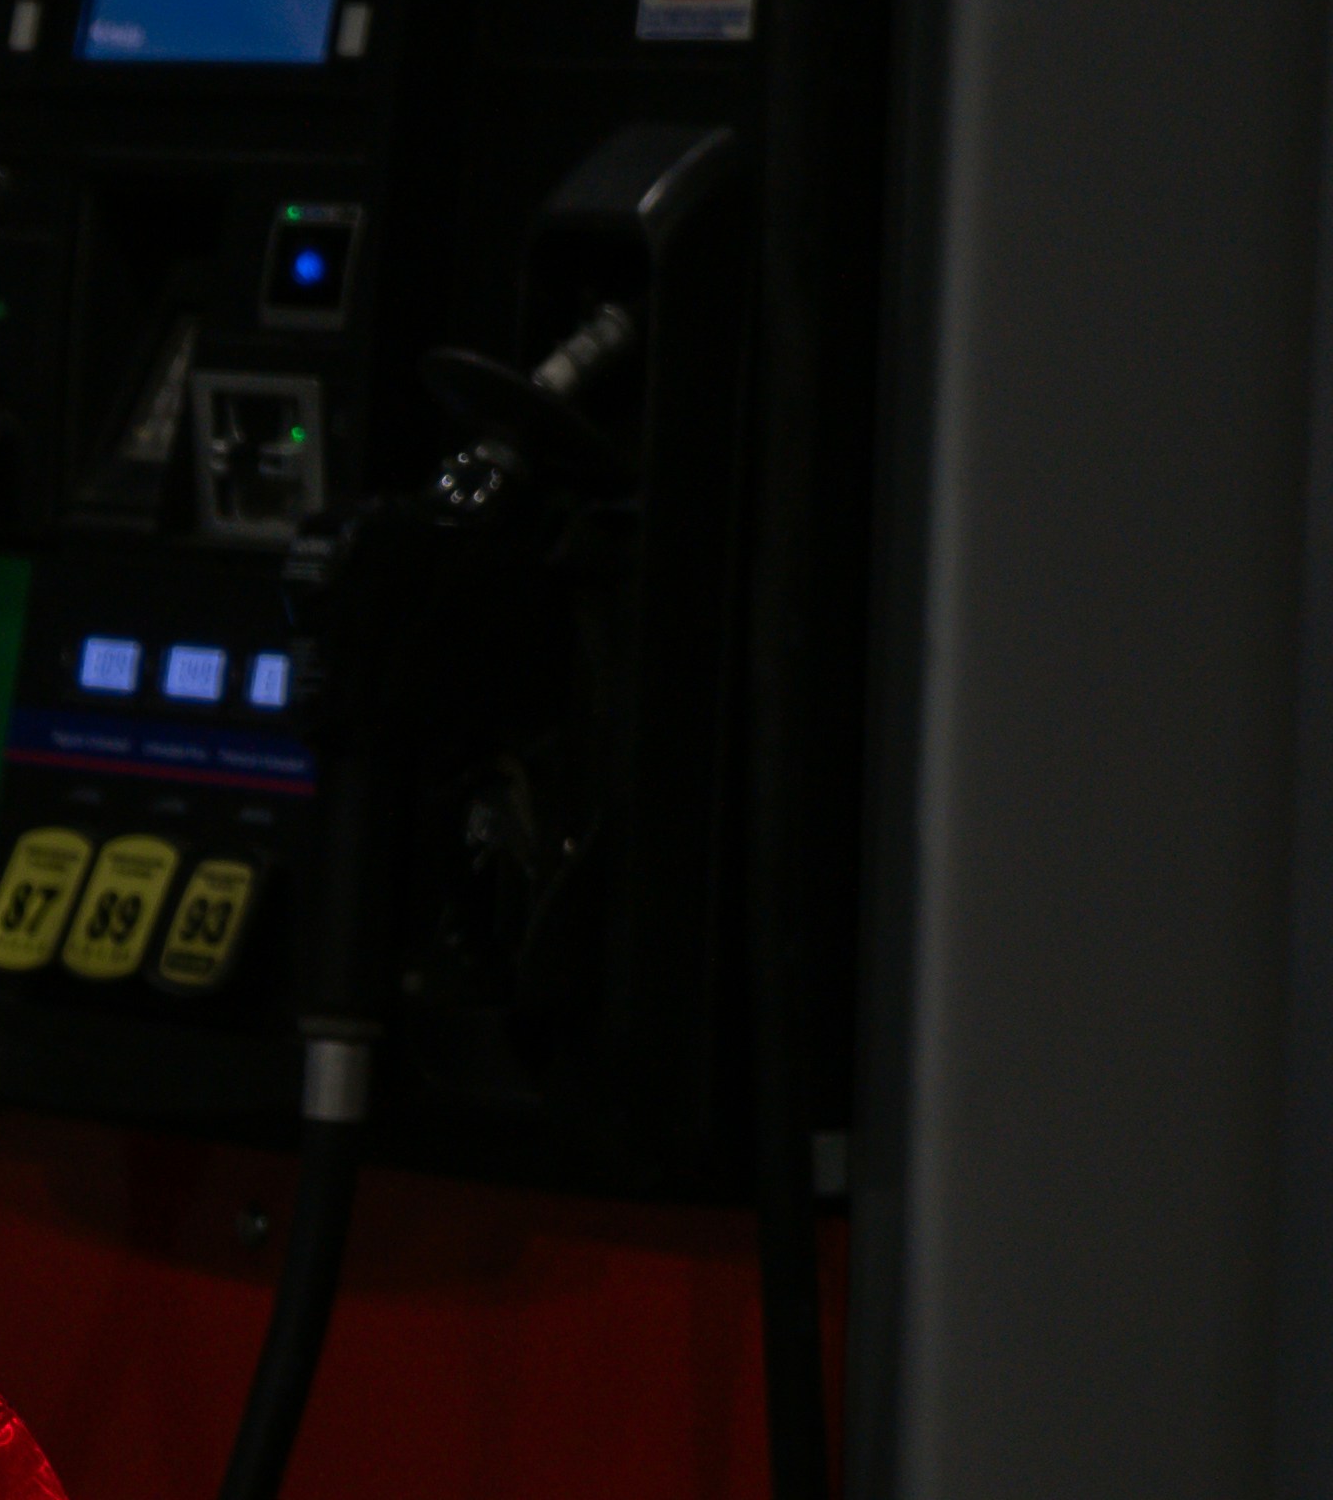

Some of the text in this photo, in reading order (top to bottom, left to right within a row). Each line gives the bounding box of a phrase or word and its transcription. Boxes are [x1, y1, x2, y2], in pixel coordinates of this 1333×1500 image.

[2, 881, 58, 934] 87
[88, 889, 142, 945] 89
[180, 897, 232, 945] 93
